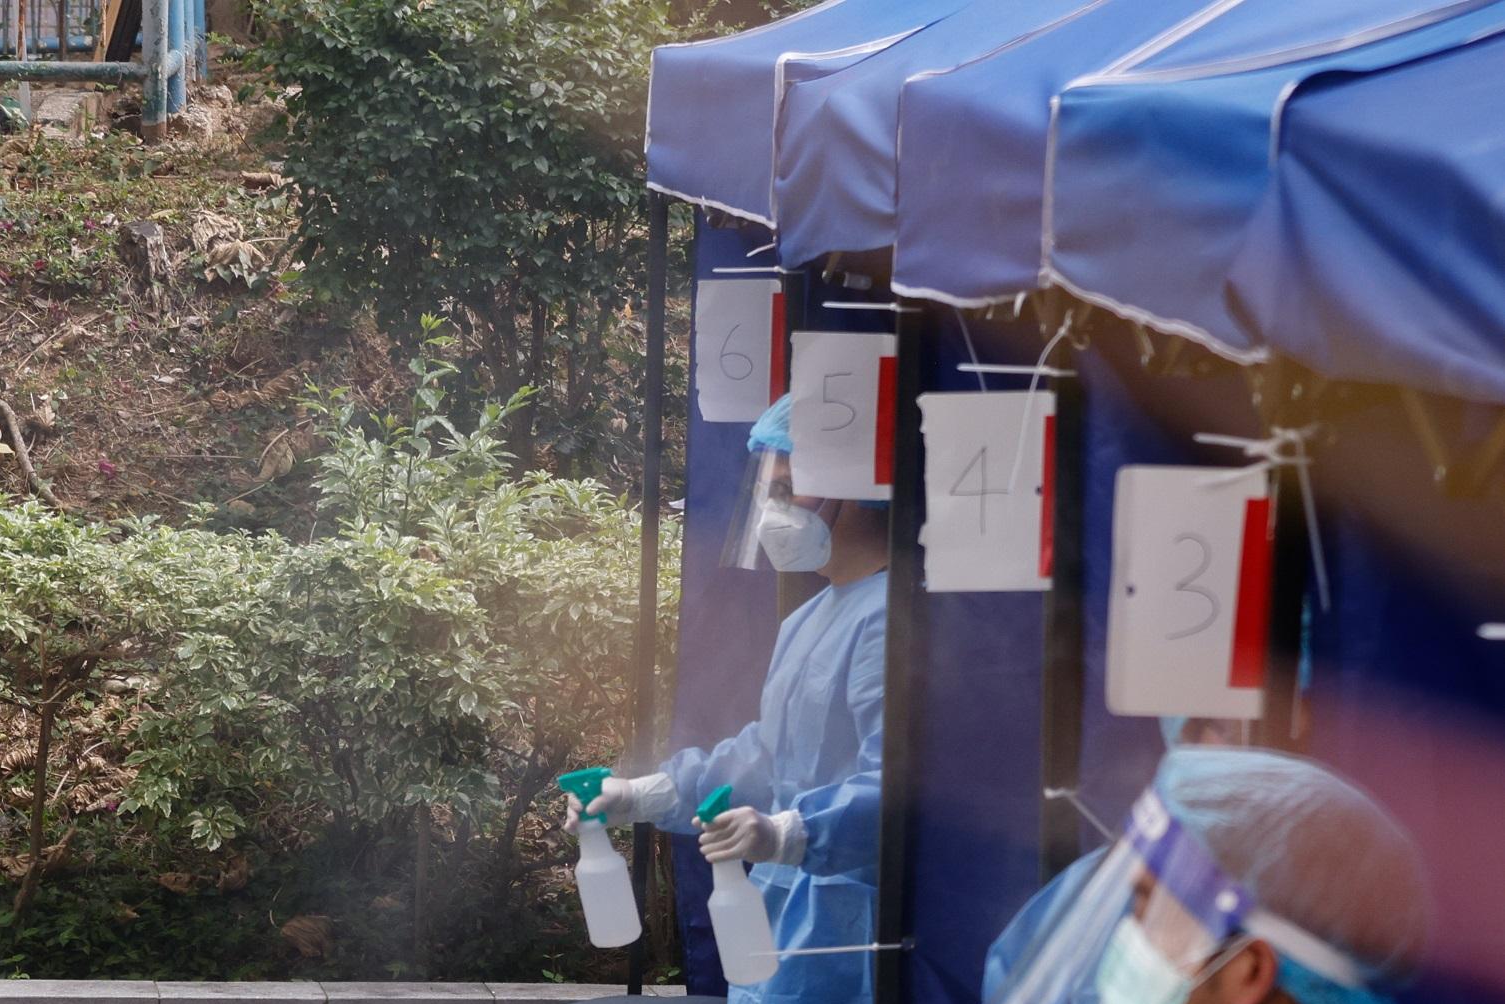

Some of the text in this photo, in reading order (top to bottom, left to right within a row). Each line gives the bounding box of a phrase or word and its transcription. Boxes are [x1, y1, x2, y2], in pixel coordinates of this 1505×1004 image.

[719, 323, 753, 381] 6
[820, 371, 856, 432] 5
[948, 446, 1011, 536] 4
[1165, 531, 1222, 641] 3
